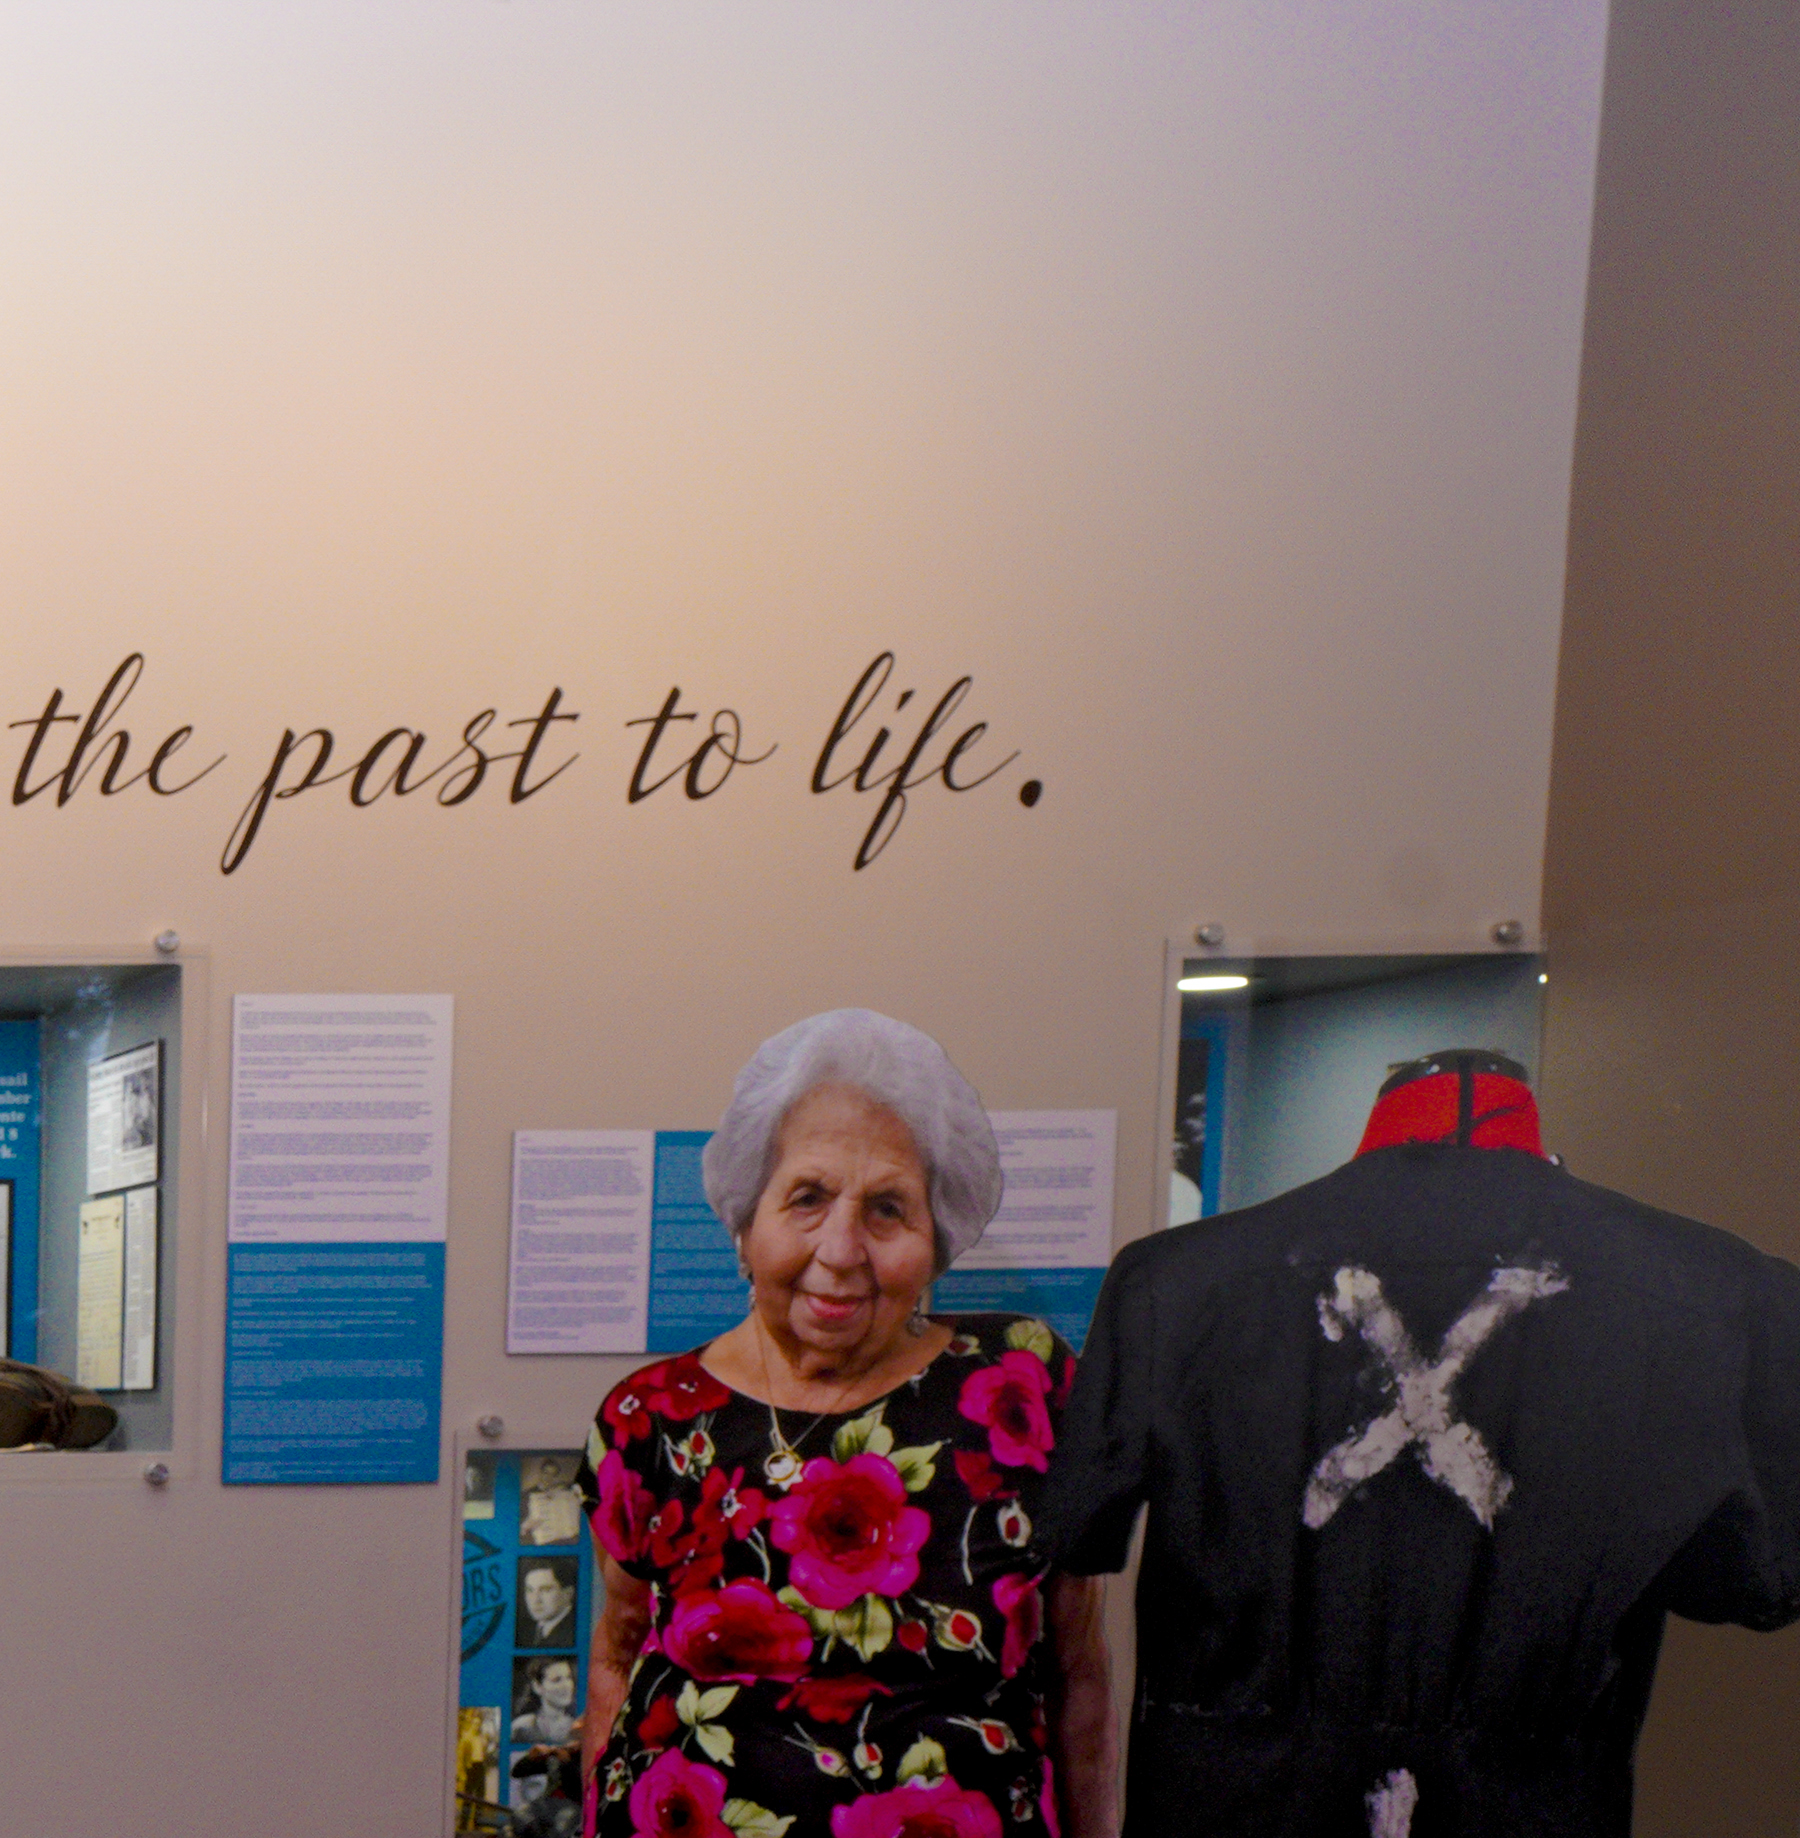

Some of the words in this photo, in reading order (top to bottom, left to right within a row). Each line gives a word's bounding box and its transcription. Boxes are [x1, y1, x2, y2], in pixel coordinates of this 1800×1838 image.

[7, 651, 226, 810] the
[219, 685, 581, 877] past
[624, 685, 779, 806] to
[809, 649, 1044, 873] life.
[0, 1073, 28, 1087] sail
